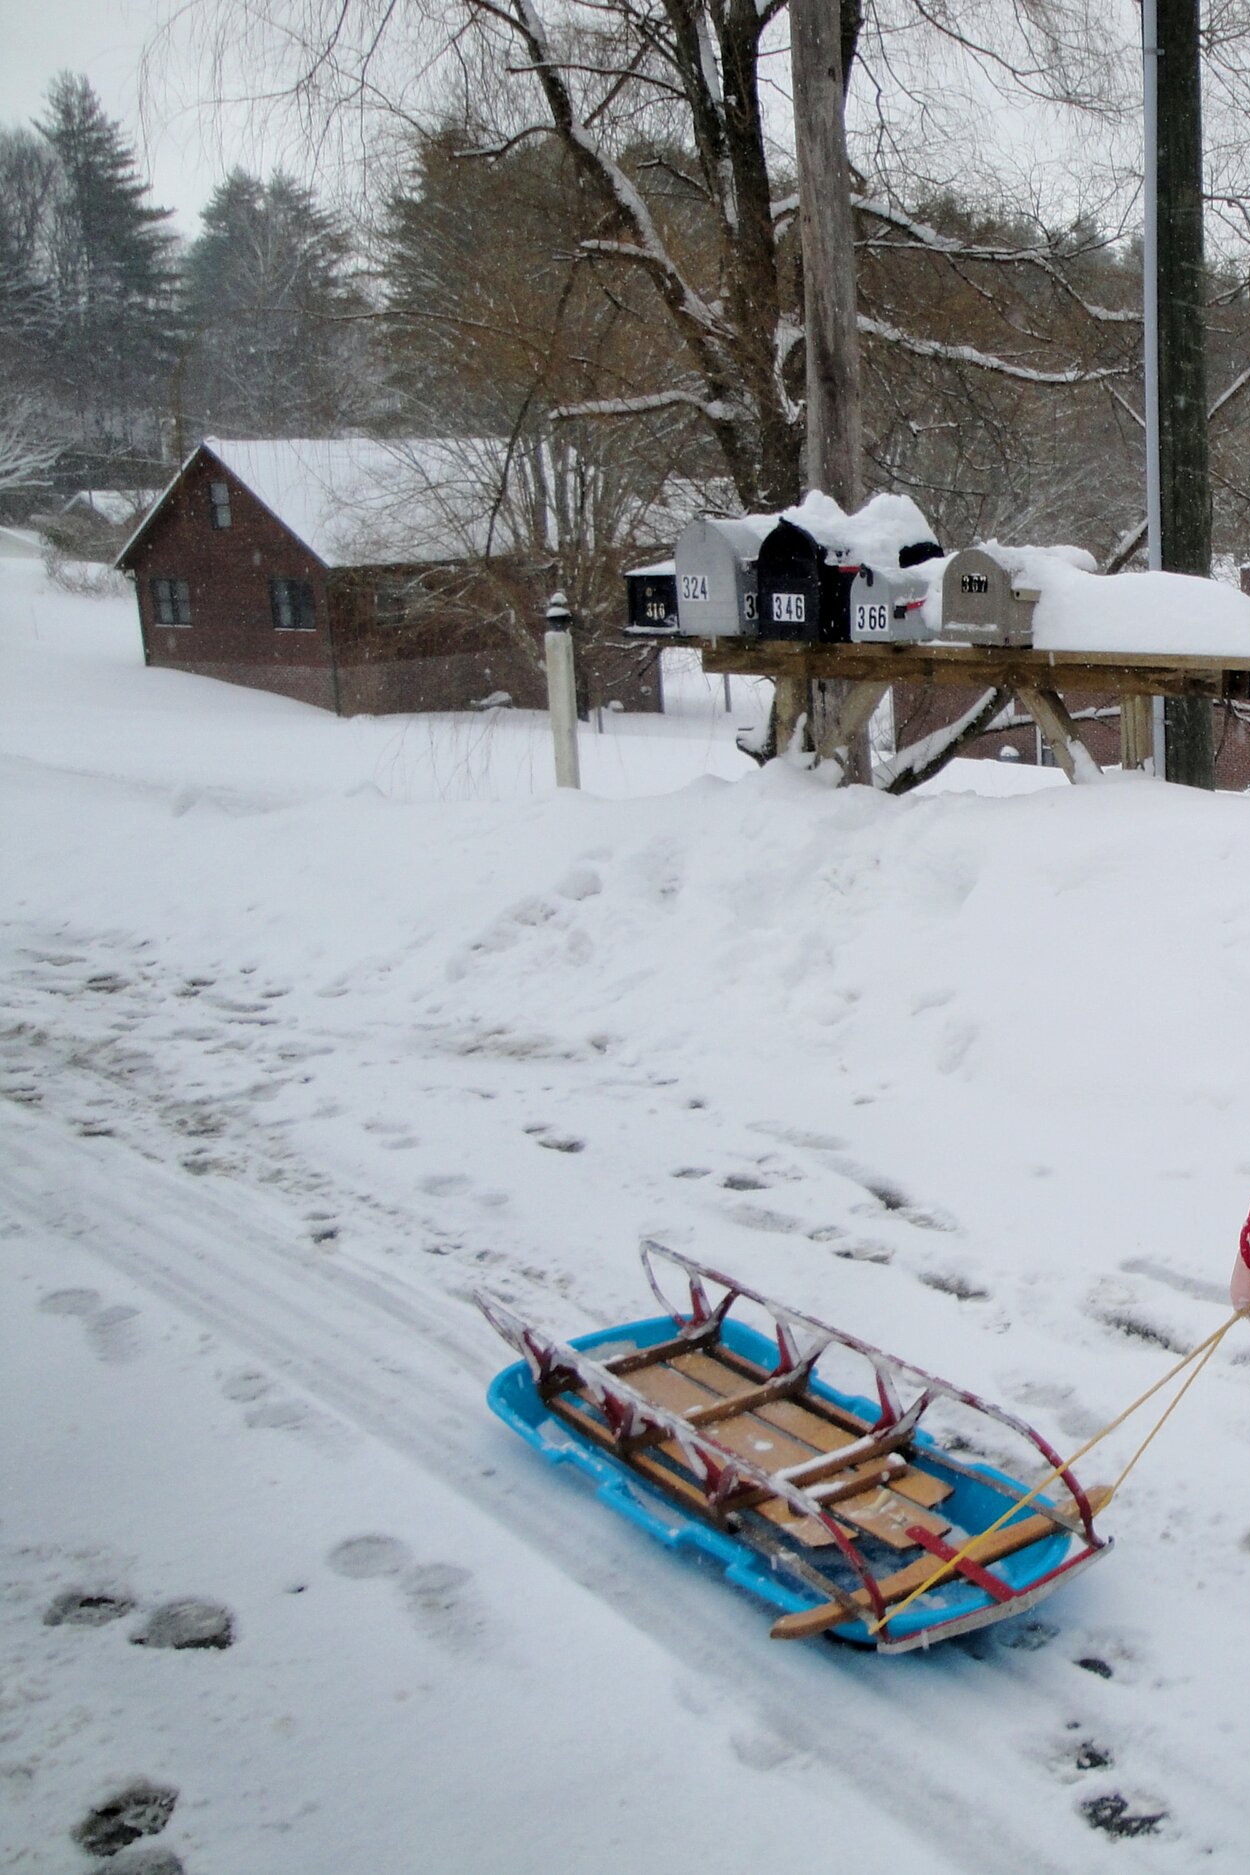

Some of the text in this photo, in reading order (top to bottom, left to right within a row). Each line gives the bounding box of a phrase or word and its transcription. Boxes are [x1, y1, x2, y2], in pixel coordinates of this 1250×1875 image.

[683, 576, 708, 600] 324
[962, 575, 986, 593] 367
[774, 596, 803, 620] 346
[858, 605, 887, 631] 366
